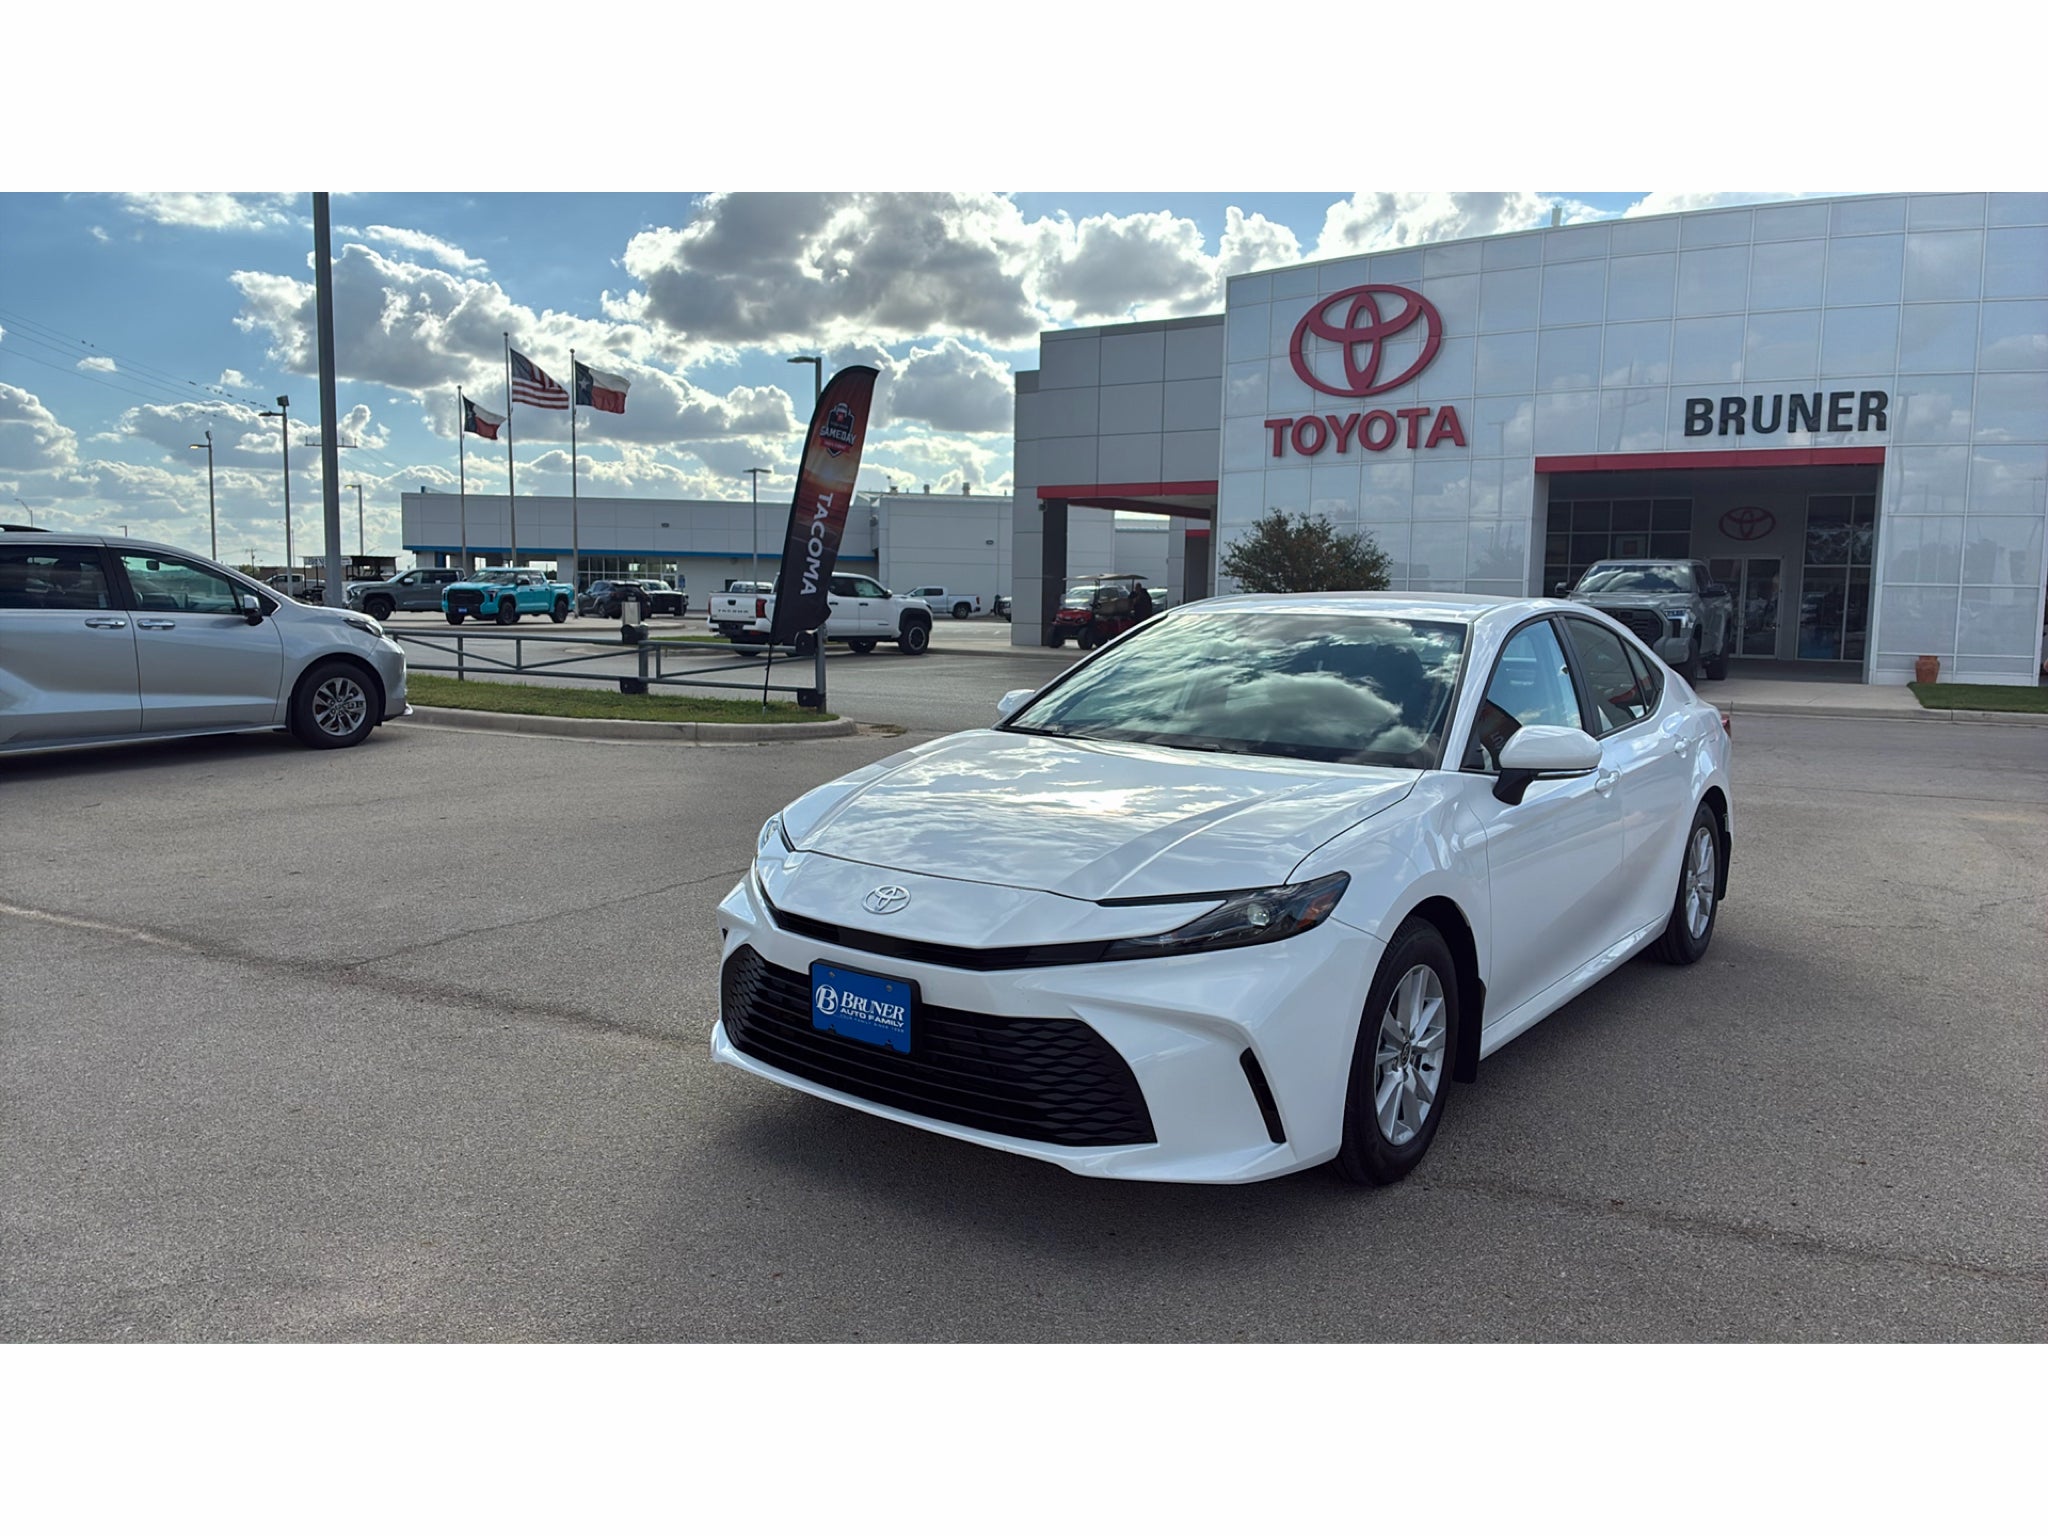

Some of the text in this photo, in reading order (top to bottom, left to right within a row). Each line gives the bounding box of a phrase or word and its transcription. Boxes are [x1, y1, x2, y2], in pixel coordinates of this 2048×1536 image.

[1264, 405, 1466, 457] TOYOTA
[1684, 390, 1889, 437] BRUNER
[800, 492, 834, 595] TACOMA
[840, 991, 905, 1021] BRUNER
[840, 1007, 905, 1028] AUTO FAMILY
